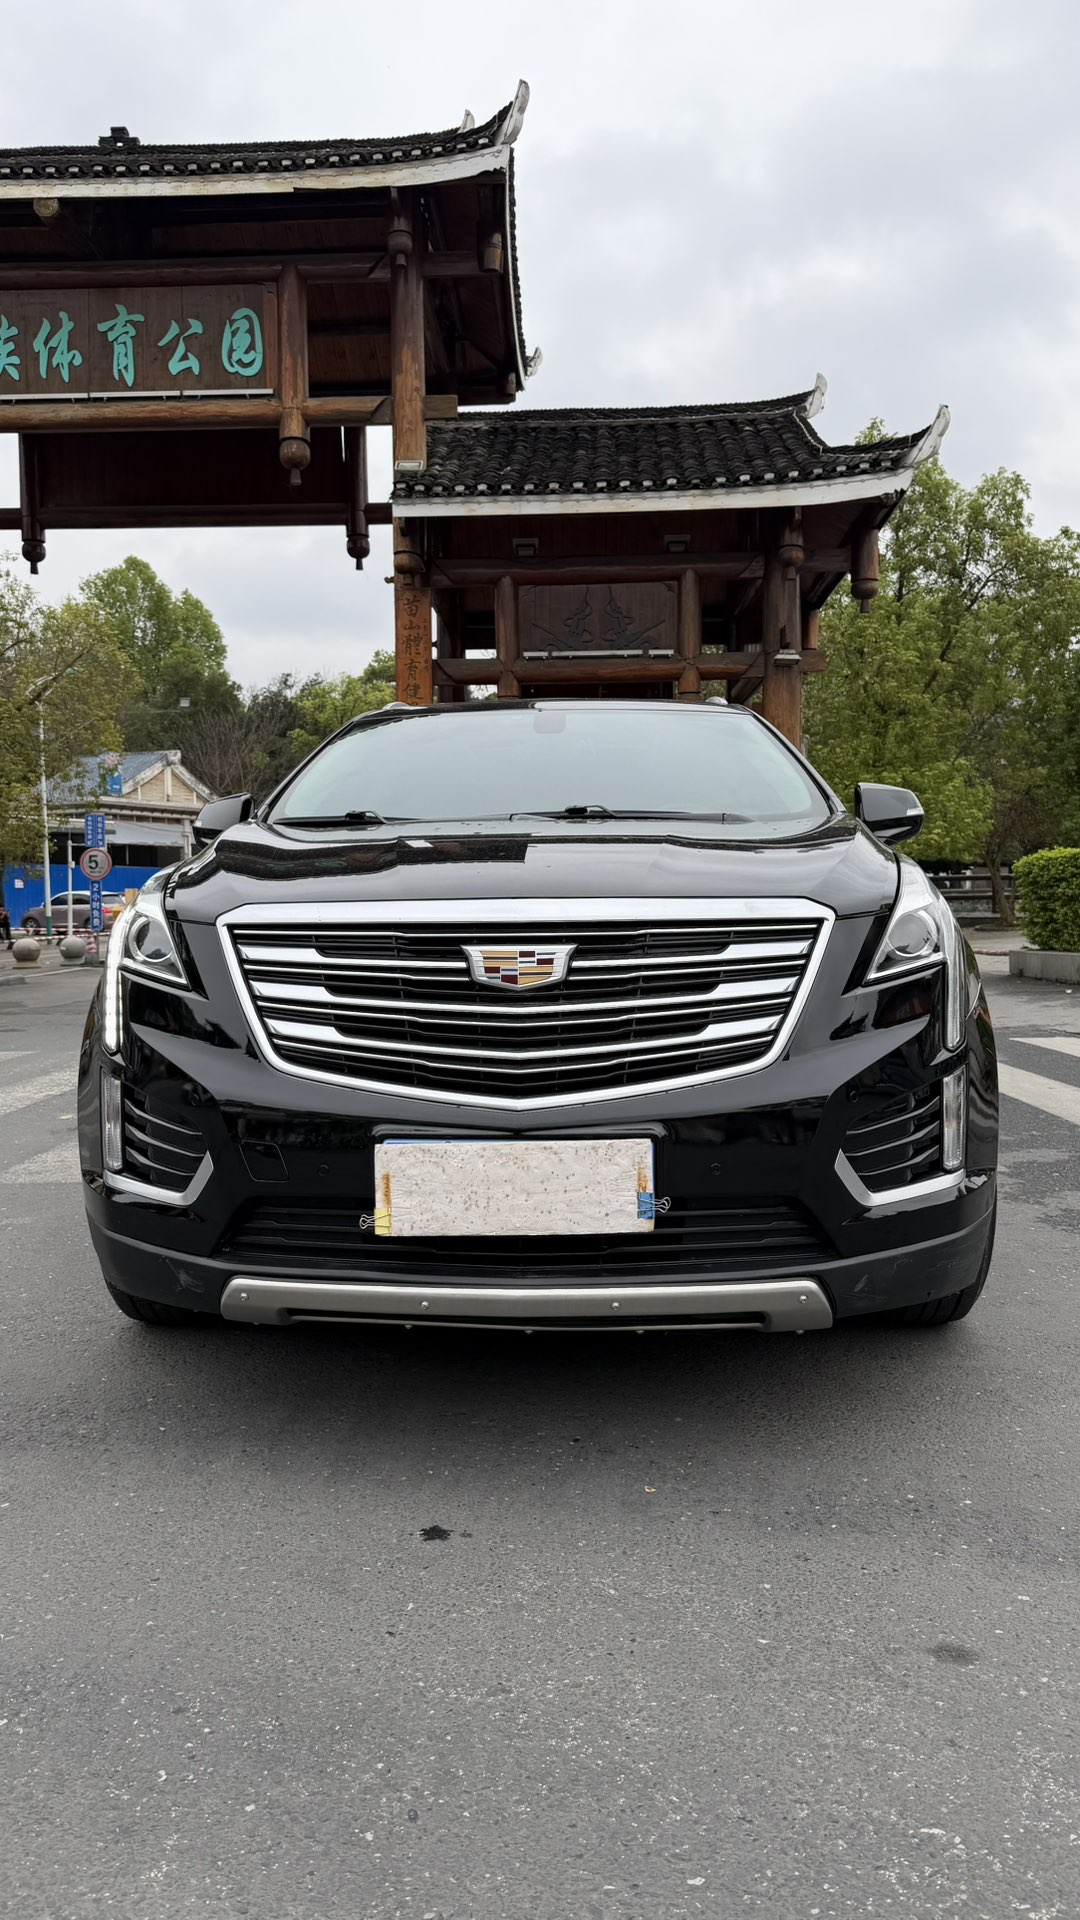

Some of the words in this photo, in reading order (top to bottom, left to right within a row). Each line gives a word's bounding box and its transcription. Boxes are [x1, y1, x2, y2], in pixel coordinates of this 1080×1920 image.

[88, 855, 99, 870] 5
[92, 883, 101, 927] 2小时免费
